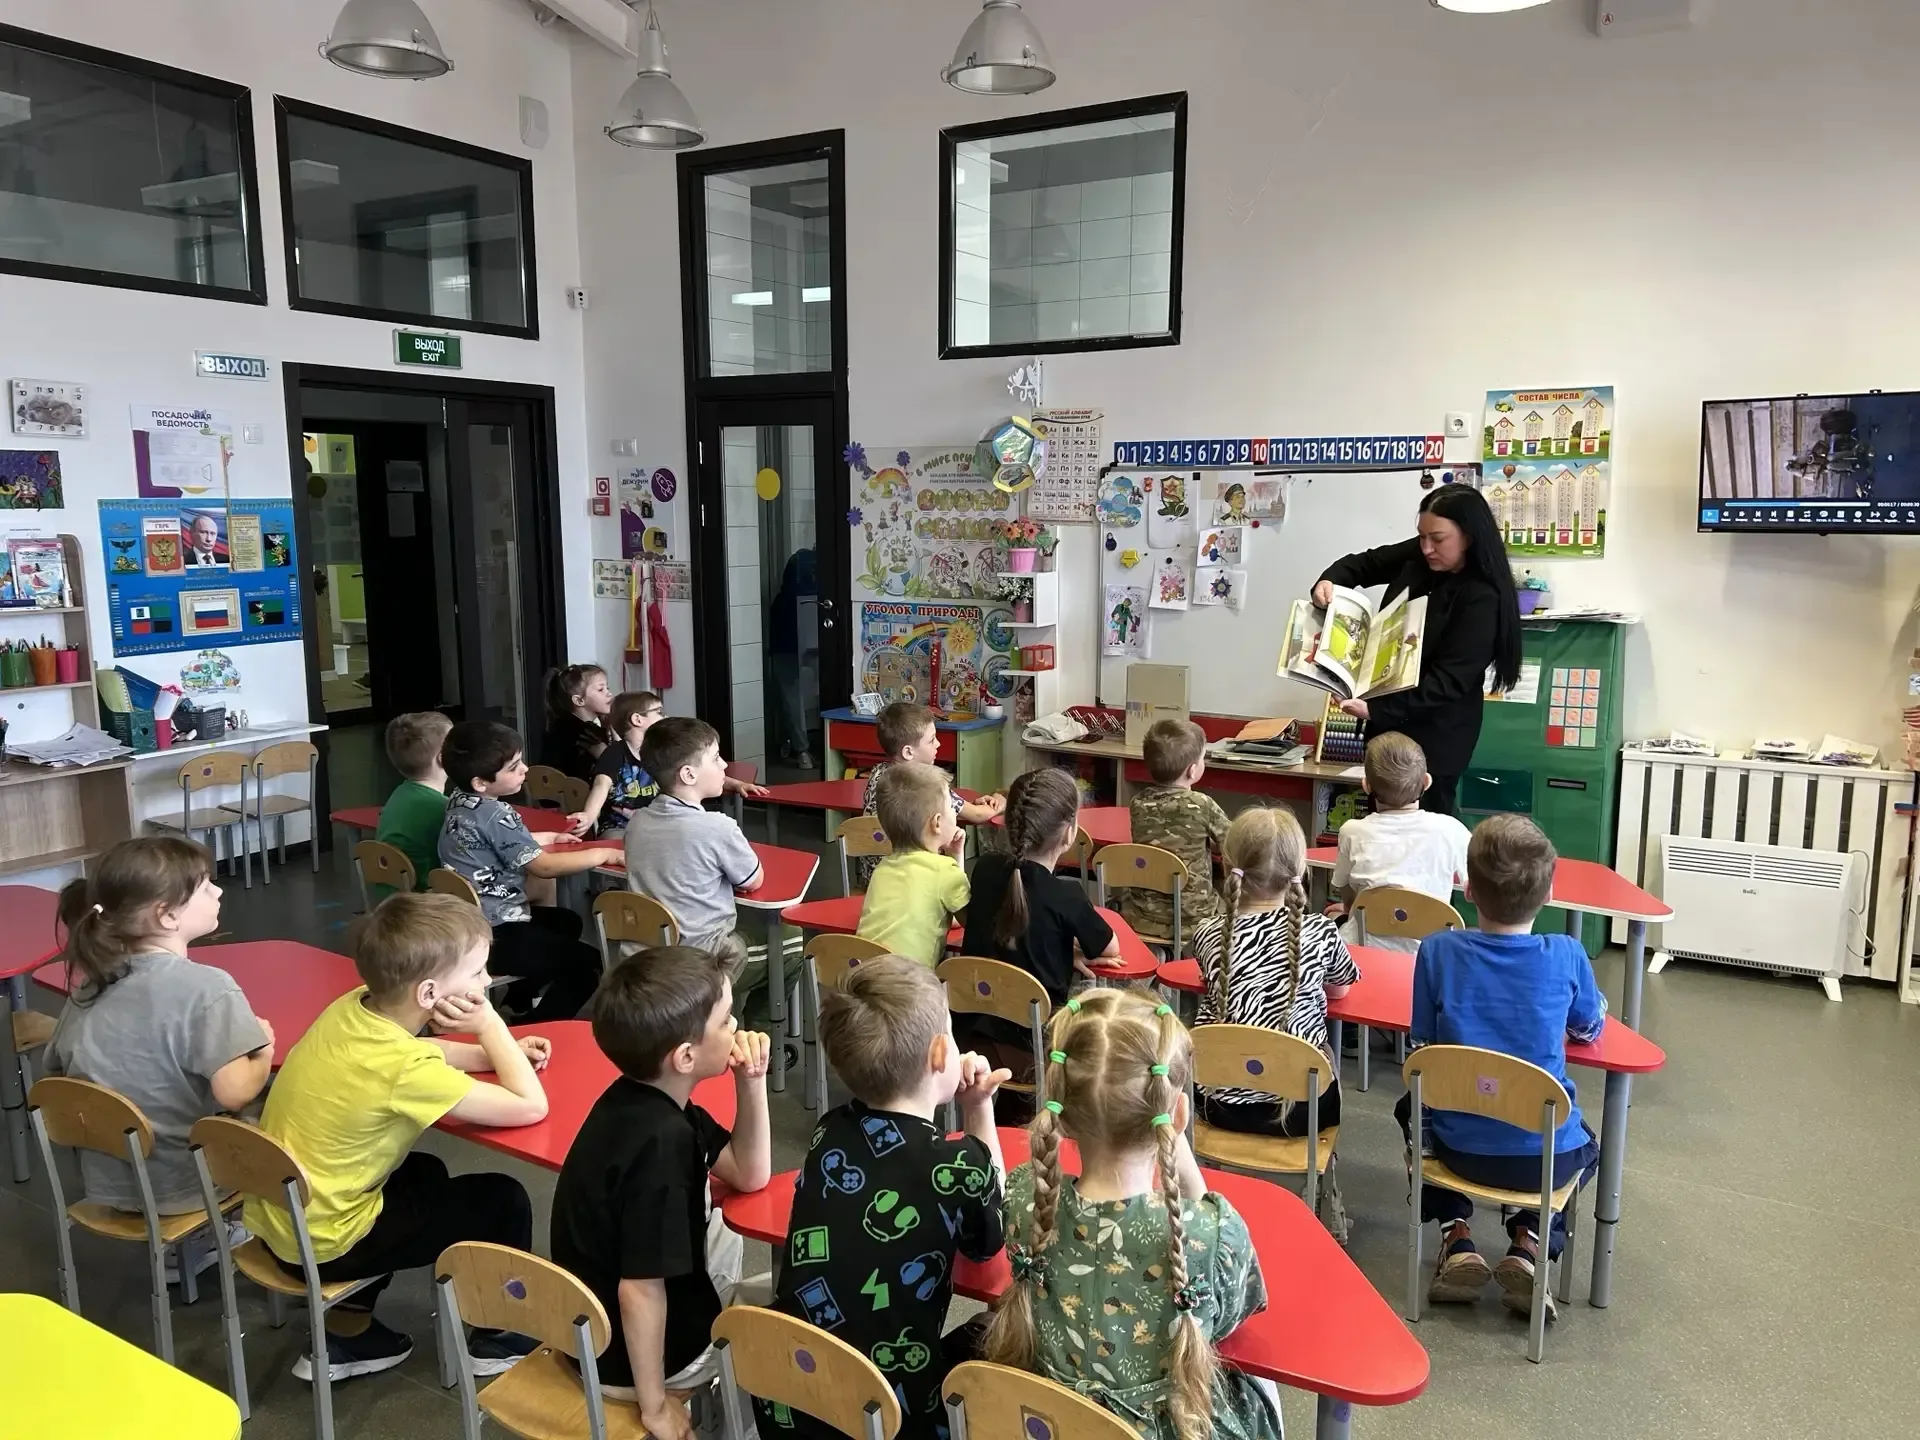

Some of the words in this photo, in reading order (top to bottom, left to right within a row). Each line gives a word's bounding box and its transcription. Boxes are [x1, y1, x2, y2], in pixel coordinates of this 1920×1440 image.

[414, 338, 446, 353] ВЫХОД
[422, 352, 440, 361] EXIT
[203, 356, 263, 376] ВЫХОД
[1518, 394, 1549, 402] СОСТАВ
[1553, 392, 1580, 400] ЧИСЛА
[151, 410, 212, 420] ПОСАДОЧНАЯ
[156, 420, 209, 429] ВЕДОМОСТЬ
[1117, 446, 1125, 463] 0
[1131, 446, 1137, 462] 1
[1143, 446, 1151, 462] 2
[1156, 446, 1165, 462] 3
[1170, 445, 1178, 461] 4
[1184, 445, 1192, 461] 5
[1198, 445, 1206, 461] 6
[1213, 445, 1221, 461] 7
[1226, 444, 1235, 461] 8
[1240, 443, 1249, 461] 9
[1254, 443, 1266, 461] 10
[1270, 443, 1283, 461] 11
[1287, 443, 1301, 460] 12
[1304, 443, 1317, 460] 13
[1321, 443, 1336, 460] 14
[1338, 442, 1352, 460] 15
[1356, 442, 1371, 460] 16
[1374, 442, 1388, 460] 17
[1391, 441, 1406, 460] 18
[1409, 441, 1424, 460] 19
[1426, 441, 1442, 460] 20
[924, 454, 951, 472] МИРЕ
[865, 604, 912, 615] УГОЛОК
[918, 606, 979, 619] ПРИРОДЫ
[1484, 1083, 1491, 1092] 2
